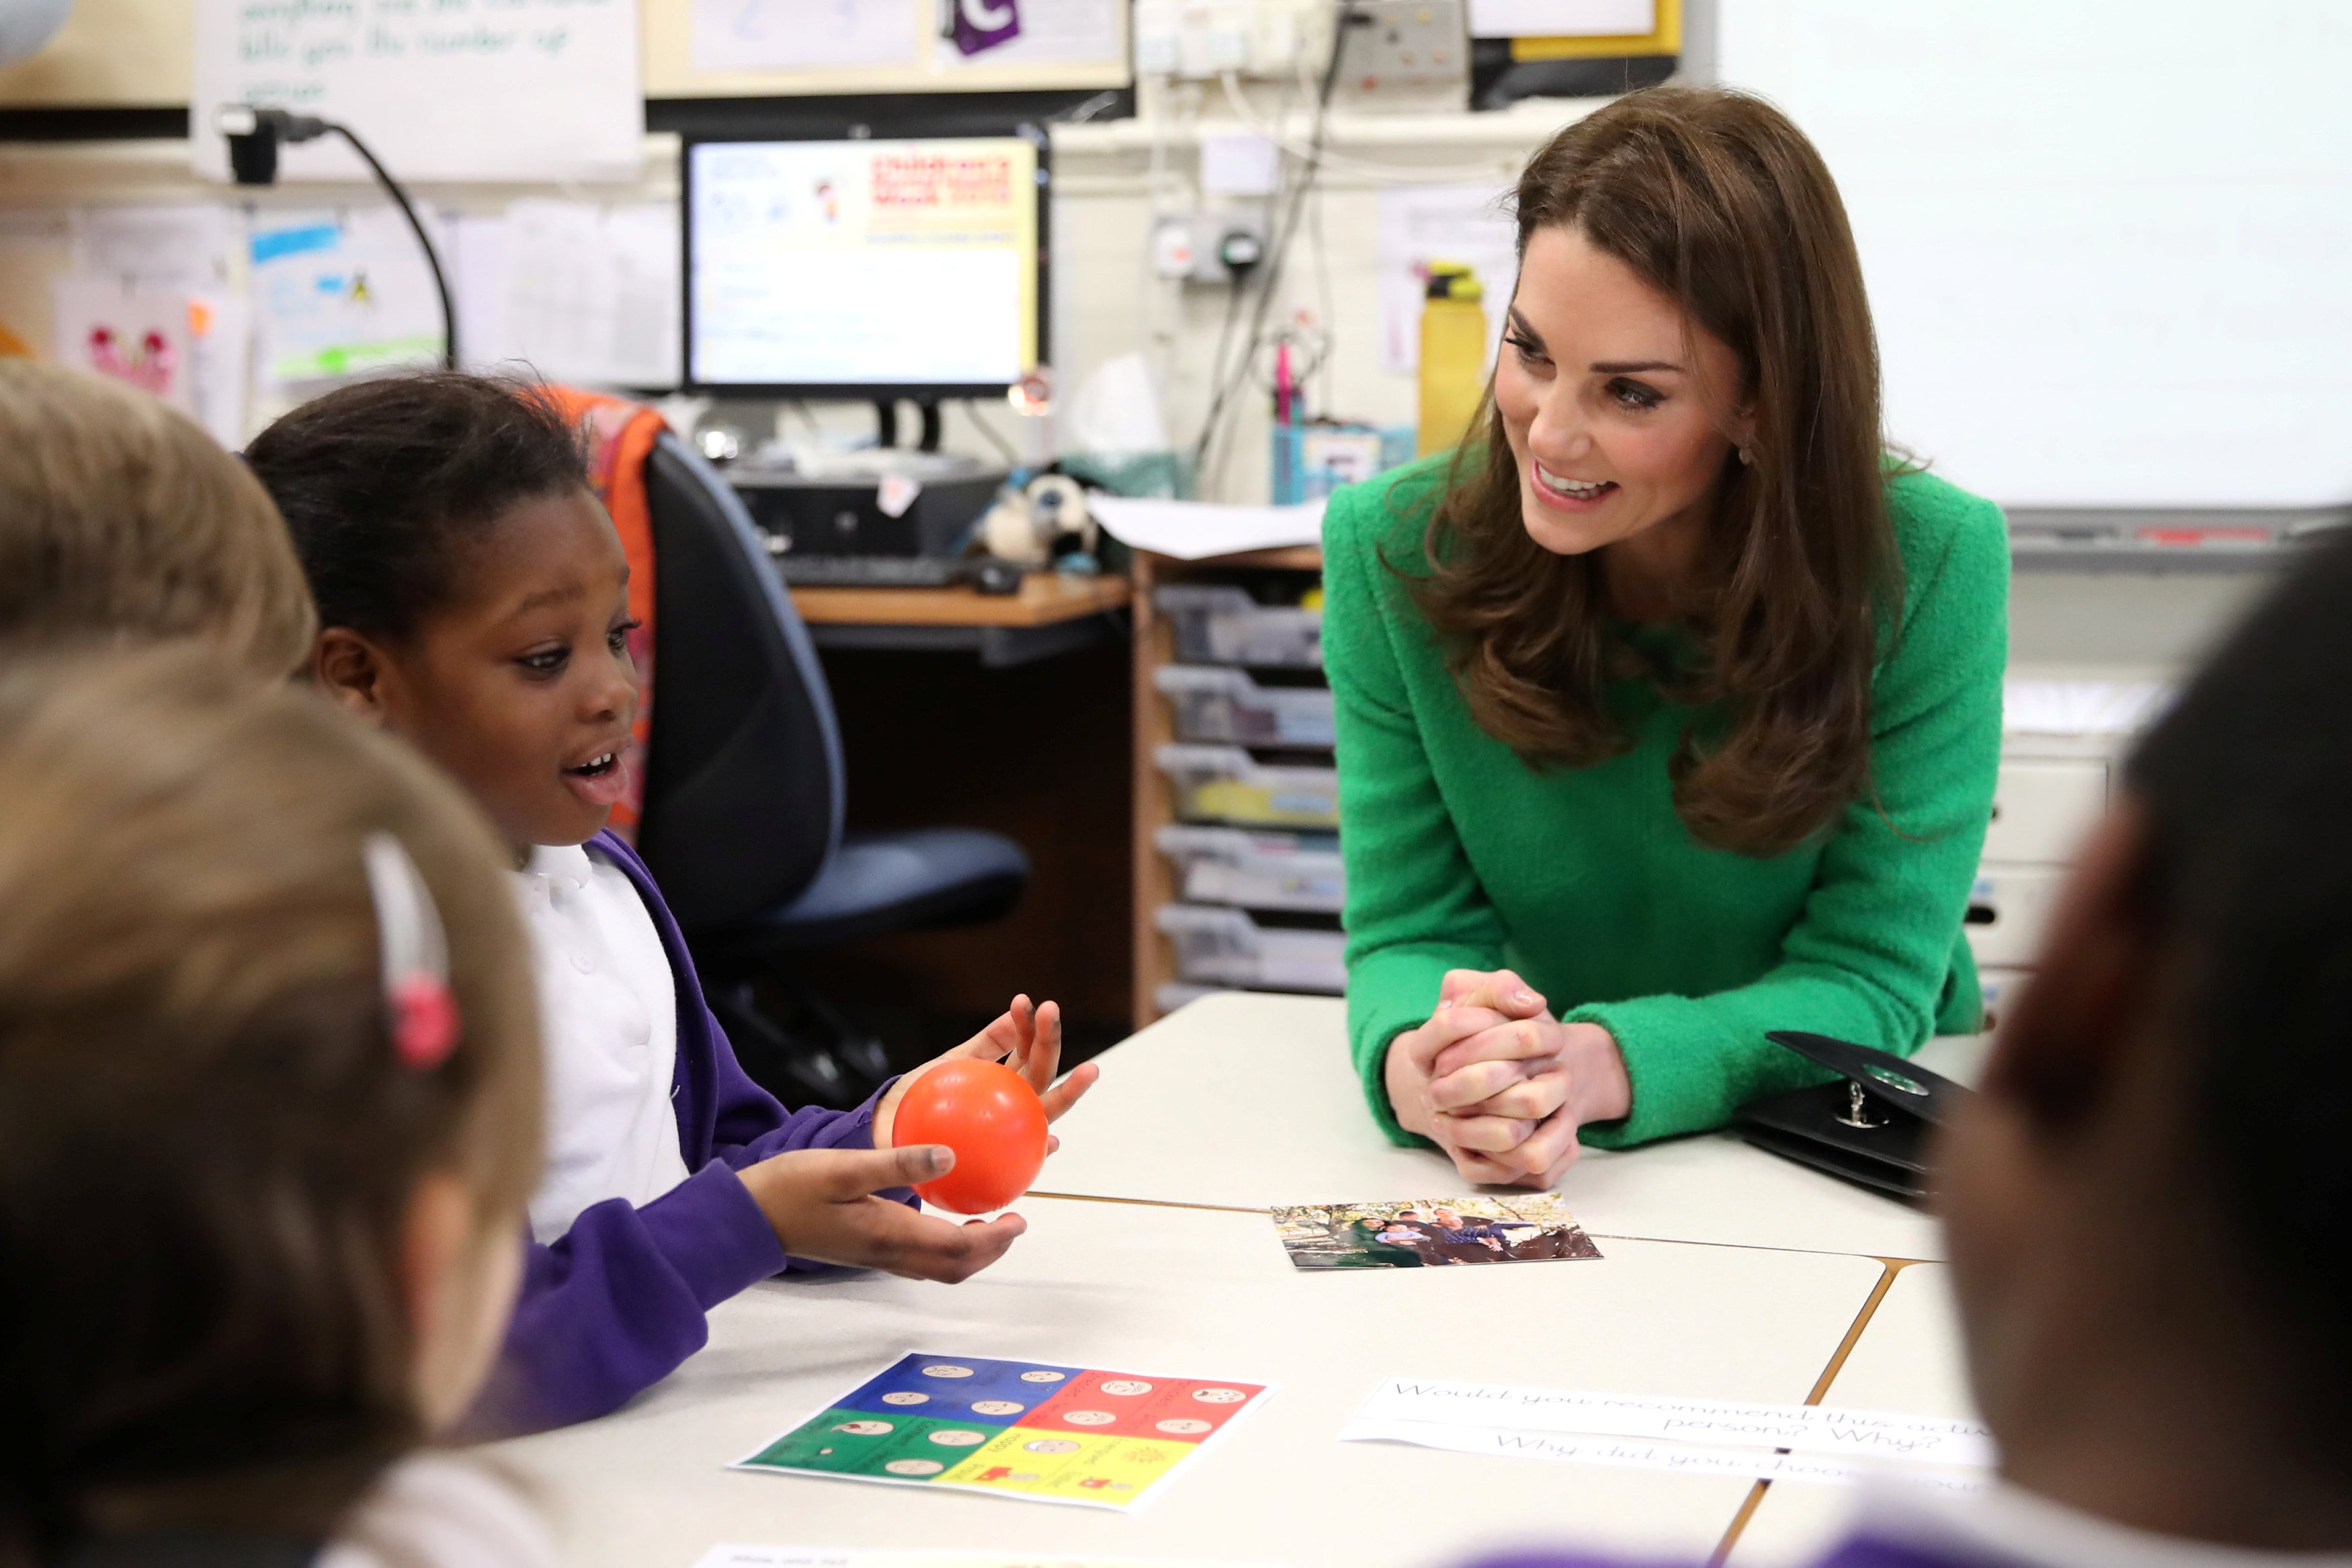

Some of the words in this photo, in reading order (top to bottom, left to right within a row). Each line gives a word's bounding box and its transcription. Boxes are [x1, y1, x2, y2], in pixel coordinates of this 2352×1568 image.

[1396, 1383, 1512, 1399] Would
[1521, 1394, 1592, 1405] you
[1603, 1401, 1814, 1422] recommend
[1826, 1413, 1894, 1428] this
[985, 1433, 1025, 1452] Happy
[1663, 1420, 1808, 1436] person?
[1831, 1427, 1941, 1452] Why?
[1497, 1434, 1584, 1458] Why
[1597, 1445, 1657, 1461] did
[1668, 1455, 1742, 1467] you
[1755, 1459, 1843, 1477] choo
